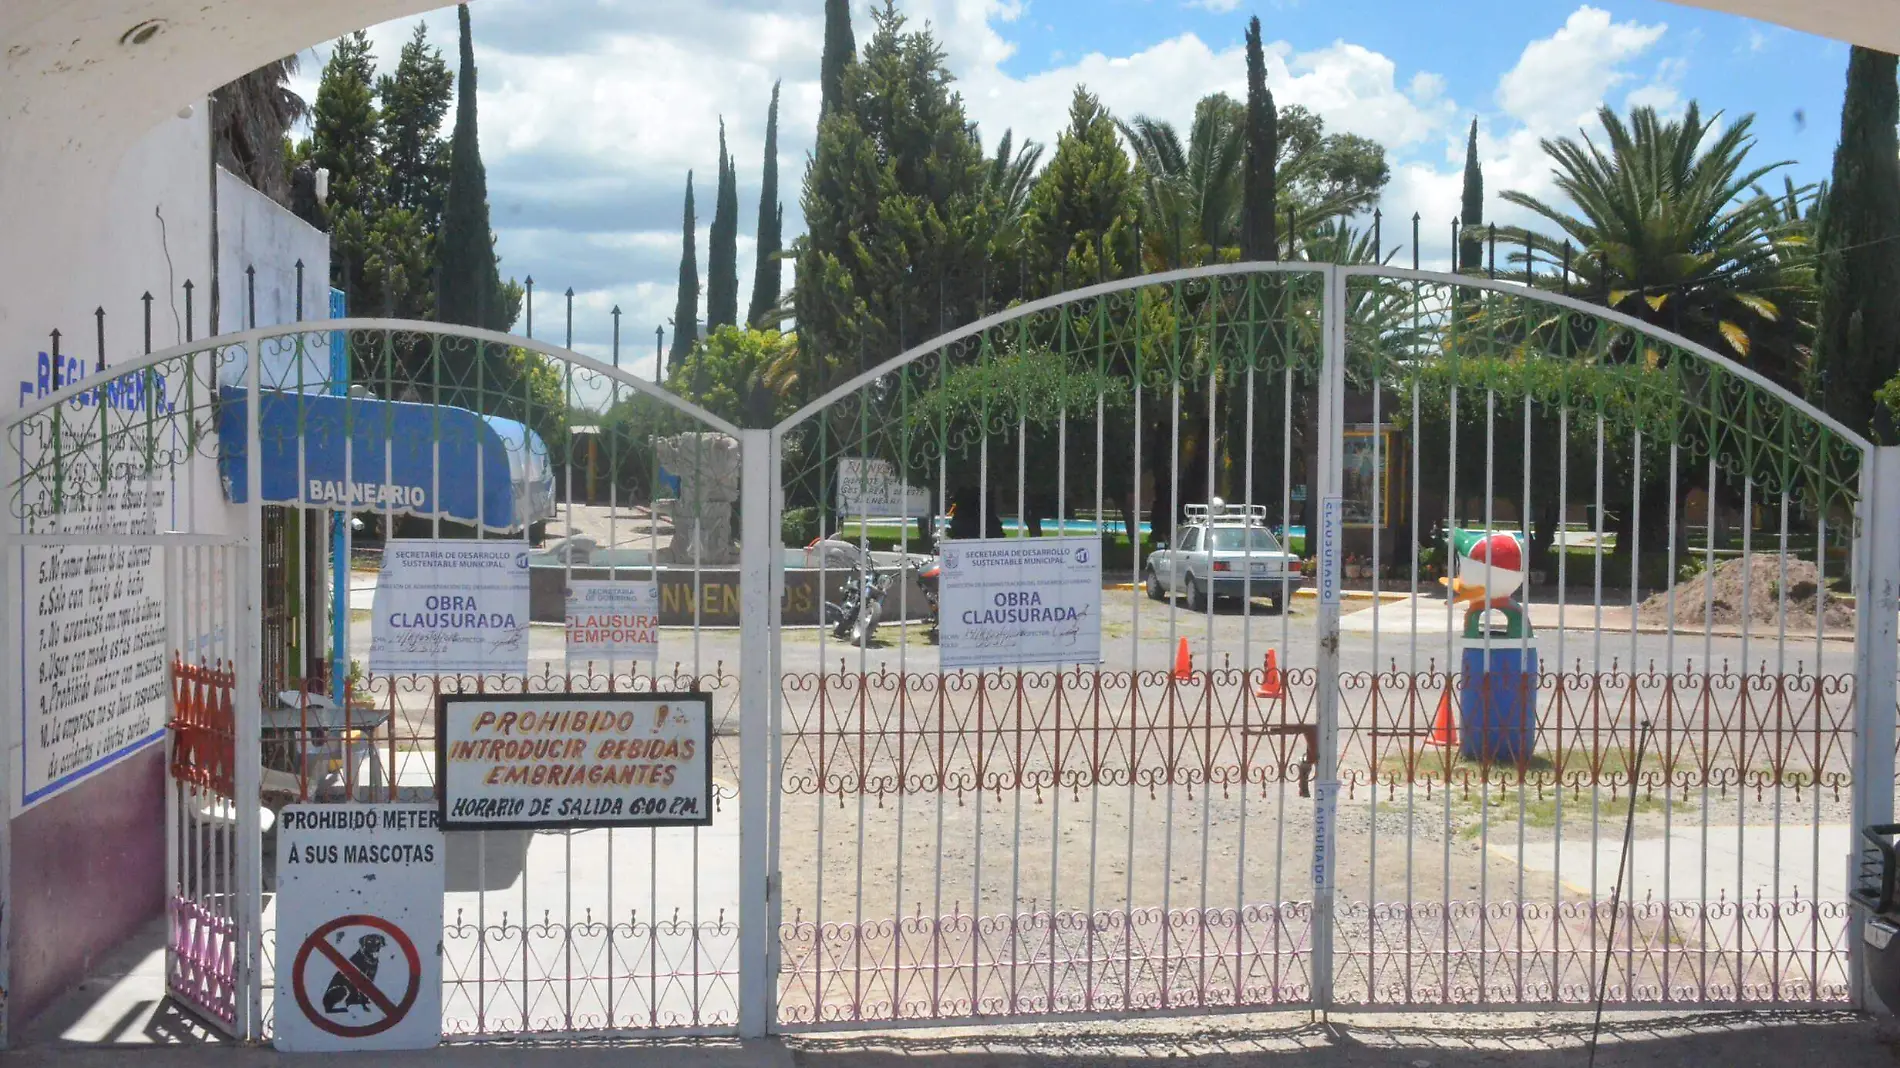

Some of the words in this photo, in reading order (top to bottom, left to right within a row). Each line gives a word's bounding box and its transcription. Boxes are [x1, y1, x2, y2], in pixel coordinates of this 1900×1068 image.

[309, 479, 426, 507] BALNEARIO
[396, 549, 442, 559] SECRETARÍA
[458, 551, 510, 560] DESARROLLO
[1023, 547, 1070, 557] DESARROLLO
[1324, 502, 1333, 600] CLAUSURADO
[402, 560, 457, 568] SUSTENTABLE
[972, 558, 1022, 567] SUSTENTABLE
[426, 595, 477, 611] OBRA
[994, 591, 1041, 608] OBRA
[389, 612, 516, 628] CLAUSURADA
[565, 615, 658, 628] CLAUSURA
[962, 606, 1077, 625] CLAUSURADA
[566, 629, 658, 644] TEMPORAL
[471, 709, 636, 735] PROHIBIDO
[448, 738, 588, 762] INTRODUCIR
[595, 736, 696, 762] BEBIDAS
[484, 764, 678, 788] EMBRIAGANTES
[451, 797, 524, 818] HORARIO
[528, 797, 552, 816] DE
[557, 797, 623, 816] SALIDA
[629, 796, 667, 816] 6:00
[282, 810, 377, 829] PROHIBIDO
[383, 810, 439, 829] METER
[288, 845, 299, 864] A
[305, 845, 338, 864] SUS
[344, 844, 434, 864] MASCOTAS
